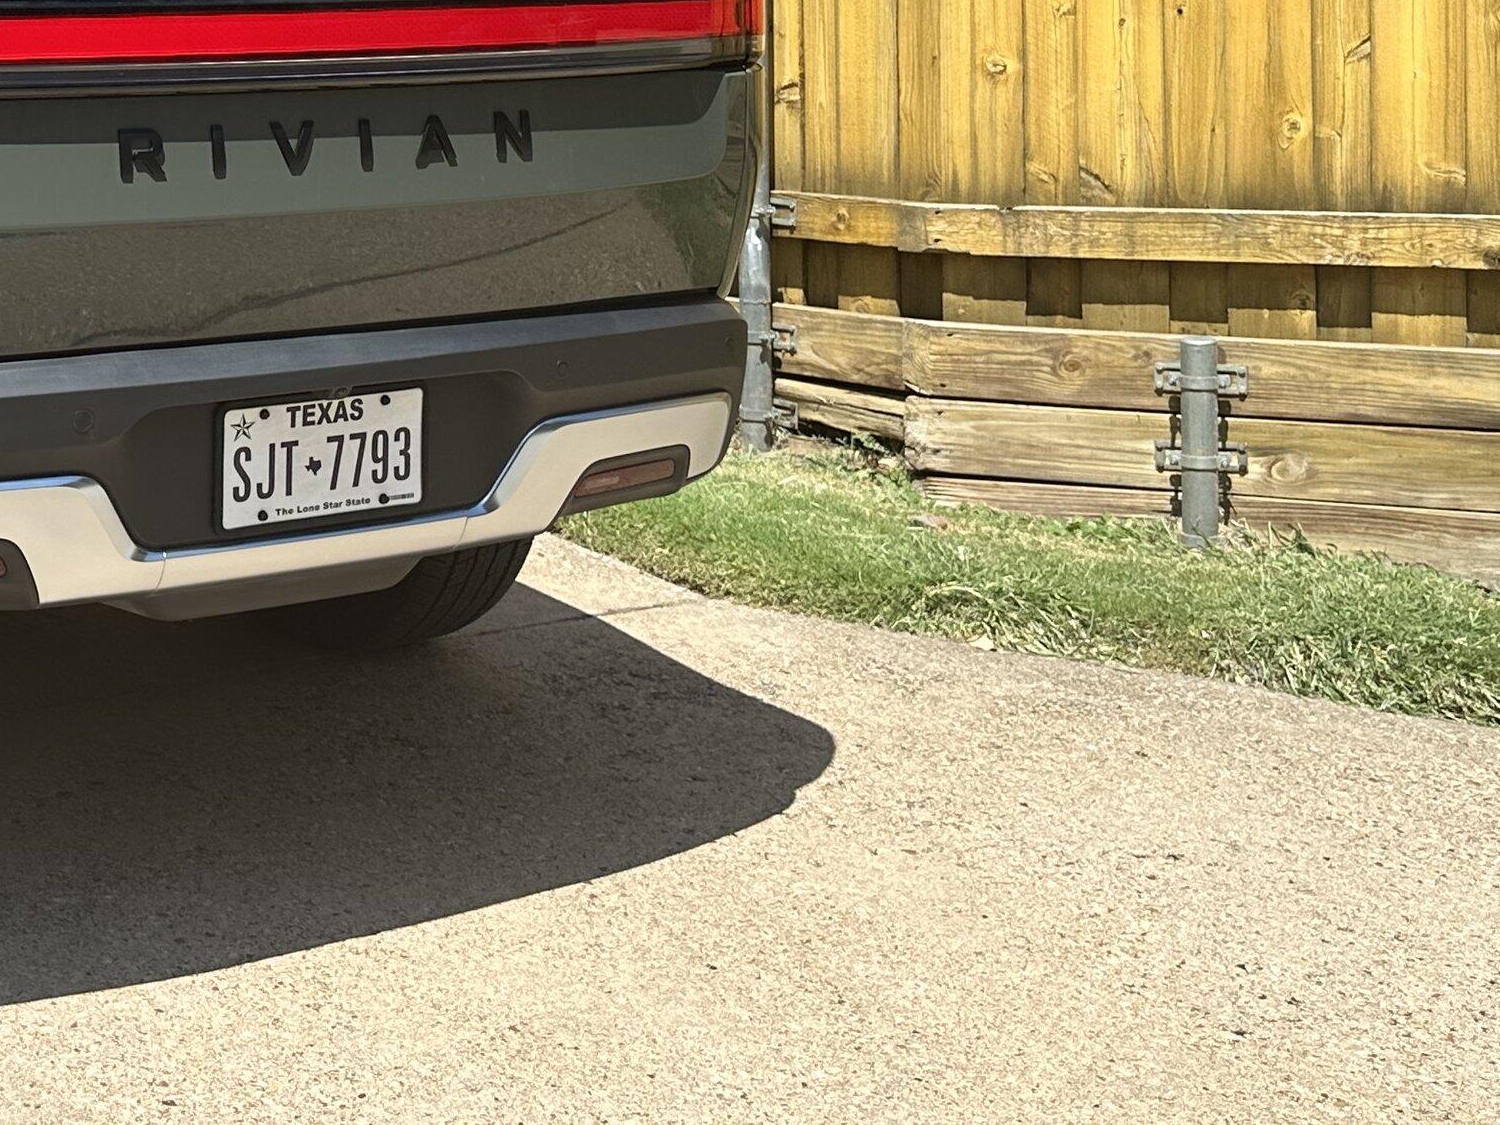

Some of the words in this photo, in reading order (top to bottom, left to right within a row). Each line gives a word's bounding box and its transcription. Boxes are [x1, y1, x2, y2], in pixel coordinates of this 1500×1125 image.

[117, 108, 534, 185] RIVIAN
[286, 397, 364, 429] TEXAS
[232, 439, 299, 503] SJT
[326, 426, 411, 491] 7793
[275, 507, 294, 516] The
[296, 504, 320, 514] Lone
[322, 500, 344, 510] Star
[345, 497, 371, 507] State
